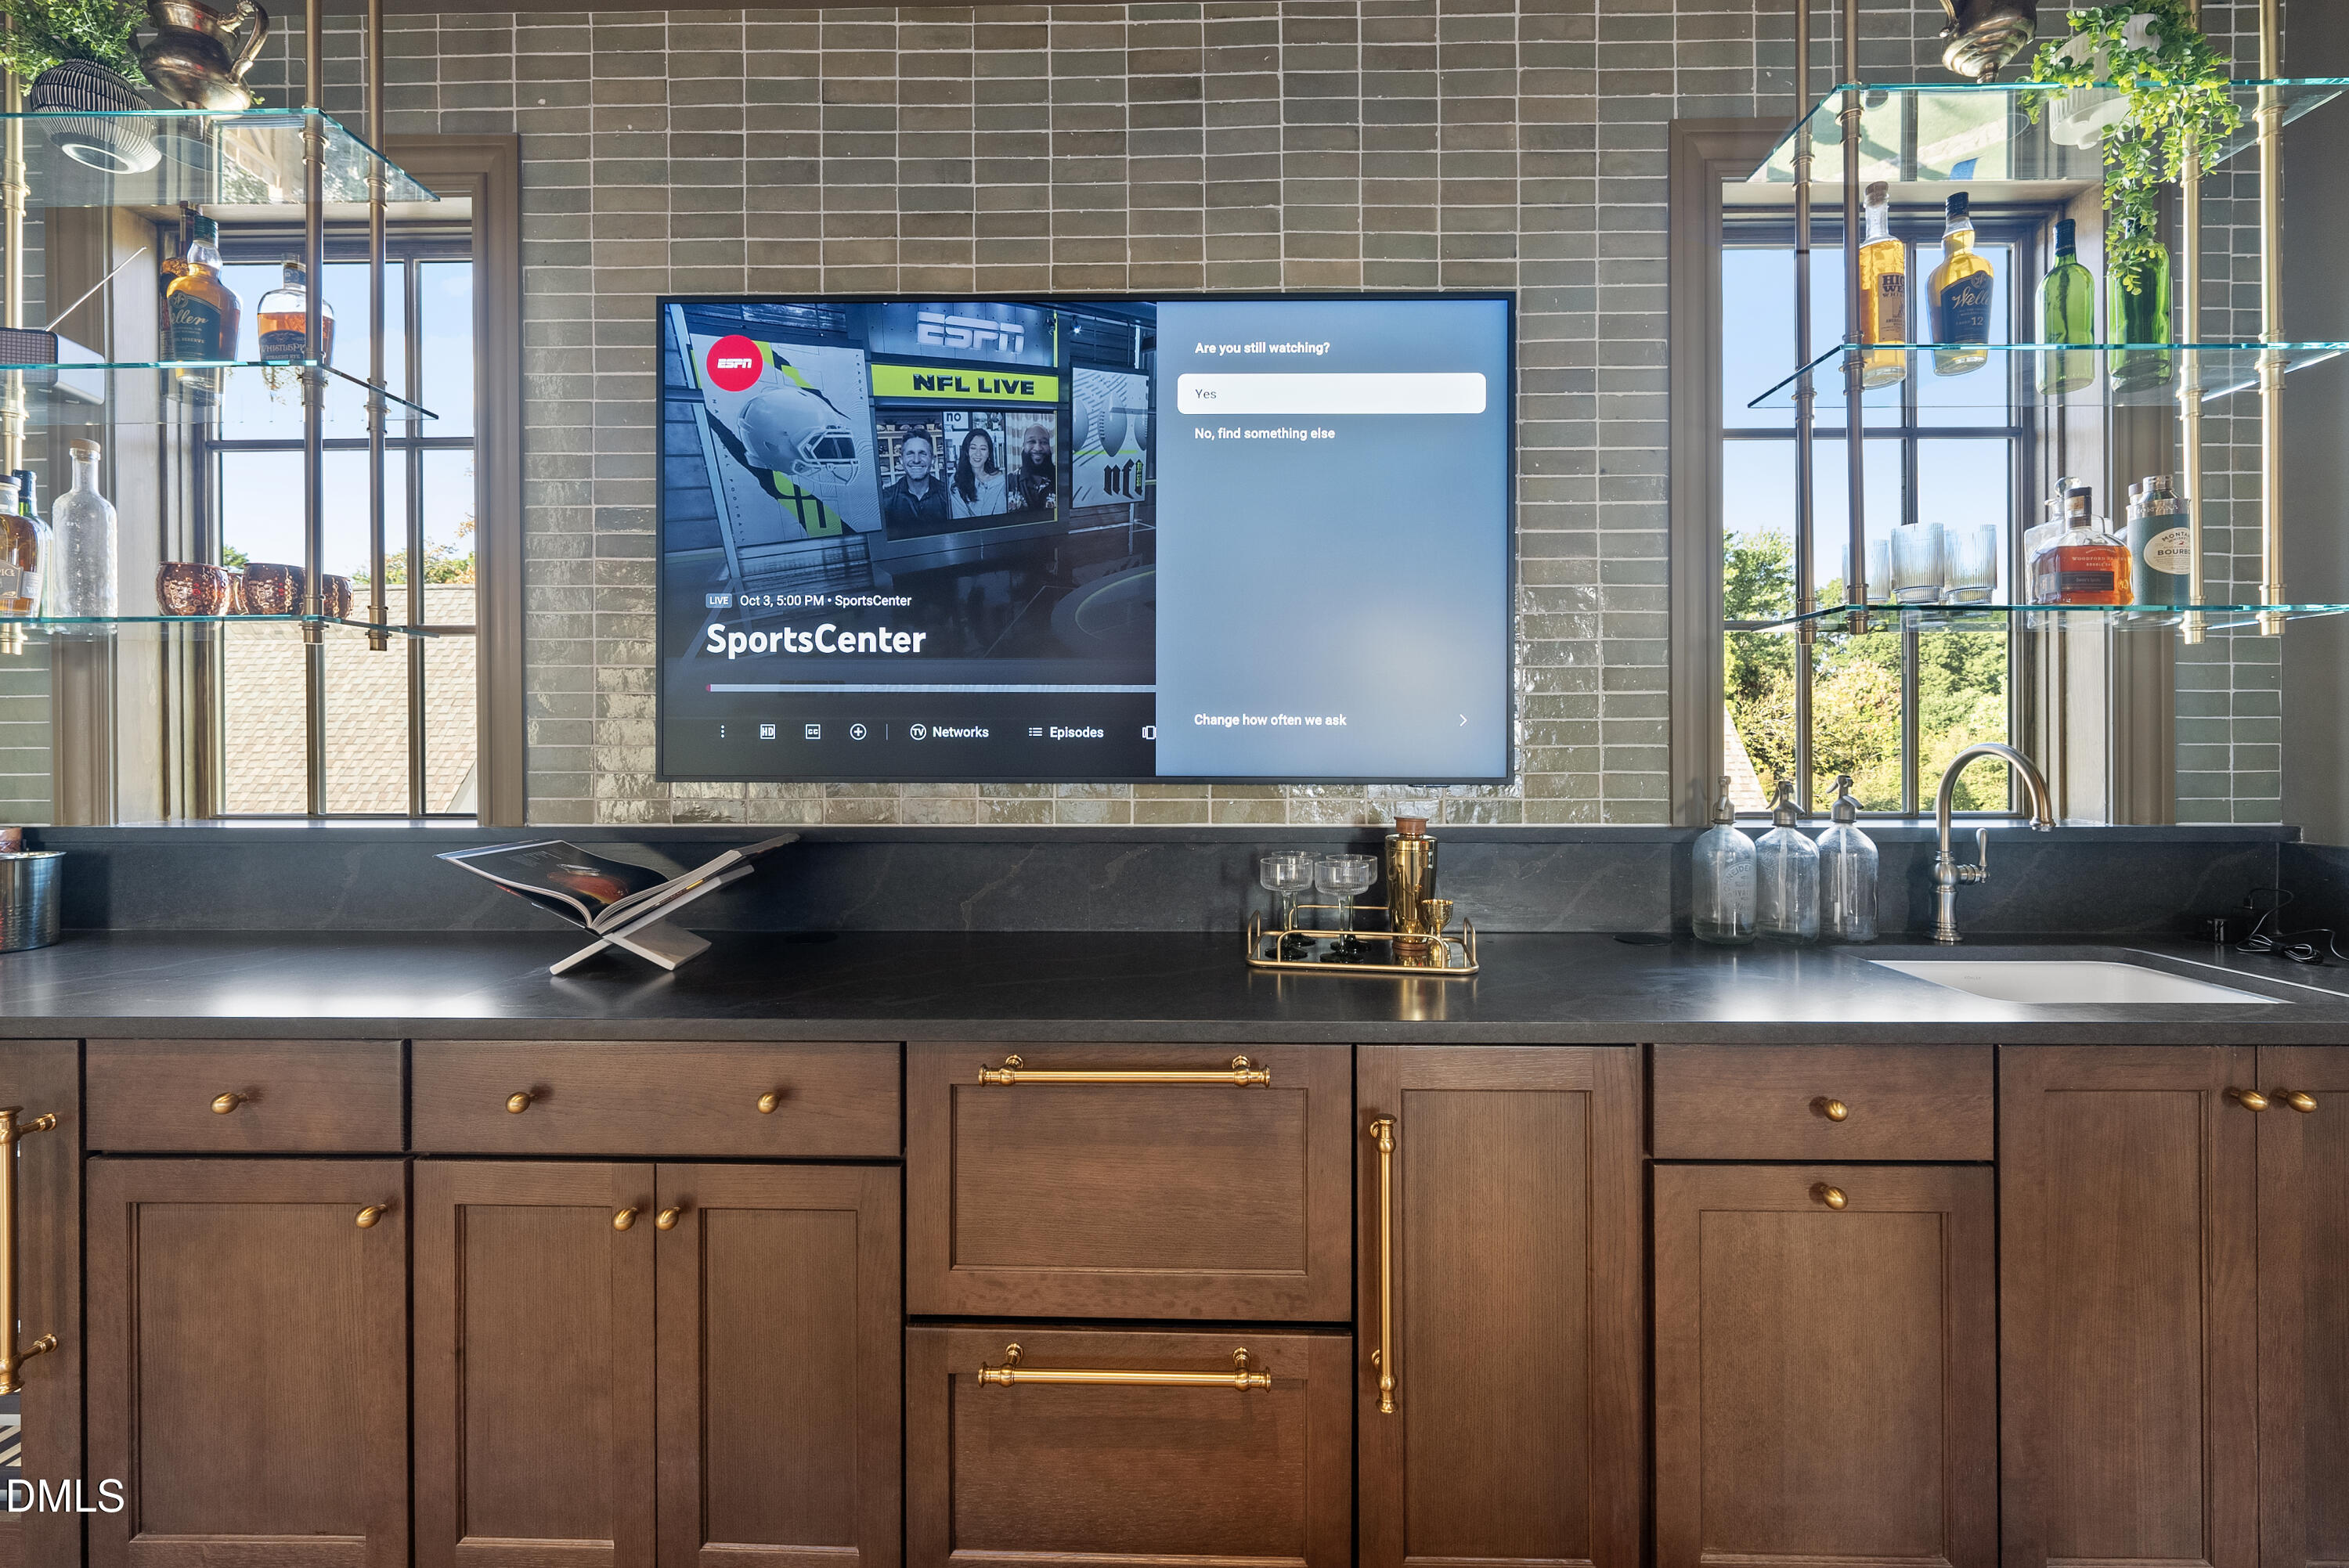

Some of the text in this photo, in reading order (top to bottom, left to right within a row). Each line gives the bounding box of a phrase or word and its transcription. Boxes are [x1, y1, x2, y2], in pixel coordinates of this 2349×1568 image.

[1972, 316, 1983, 326] 12
[917, 312, 1025, 354] ESPN
[1194, 342, 1330, 356] Are you still watching?
[717, 358, 752, 369] ESPN
[913, 373, 1034, 395] NFL LIVE
[1195, 388, 1218, 400] Yes
[946, 413, 962, 422] no
[1194, 427, 1336, 442] No, find something else
[709, 595, 912, 609] LIVE Oct 3, 5:00 PM SportsCenter
[706, 623, 927, 660] SportsCenter
[1193, 714, 1347, 728] Change how often we ask
[761, 727, 774, 737] HD
[933, 726, 990, 738] Networks
[1050, 725, 1104, 741] Episodes
